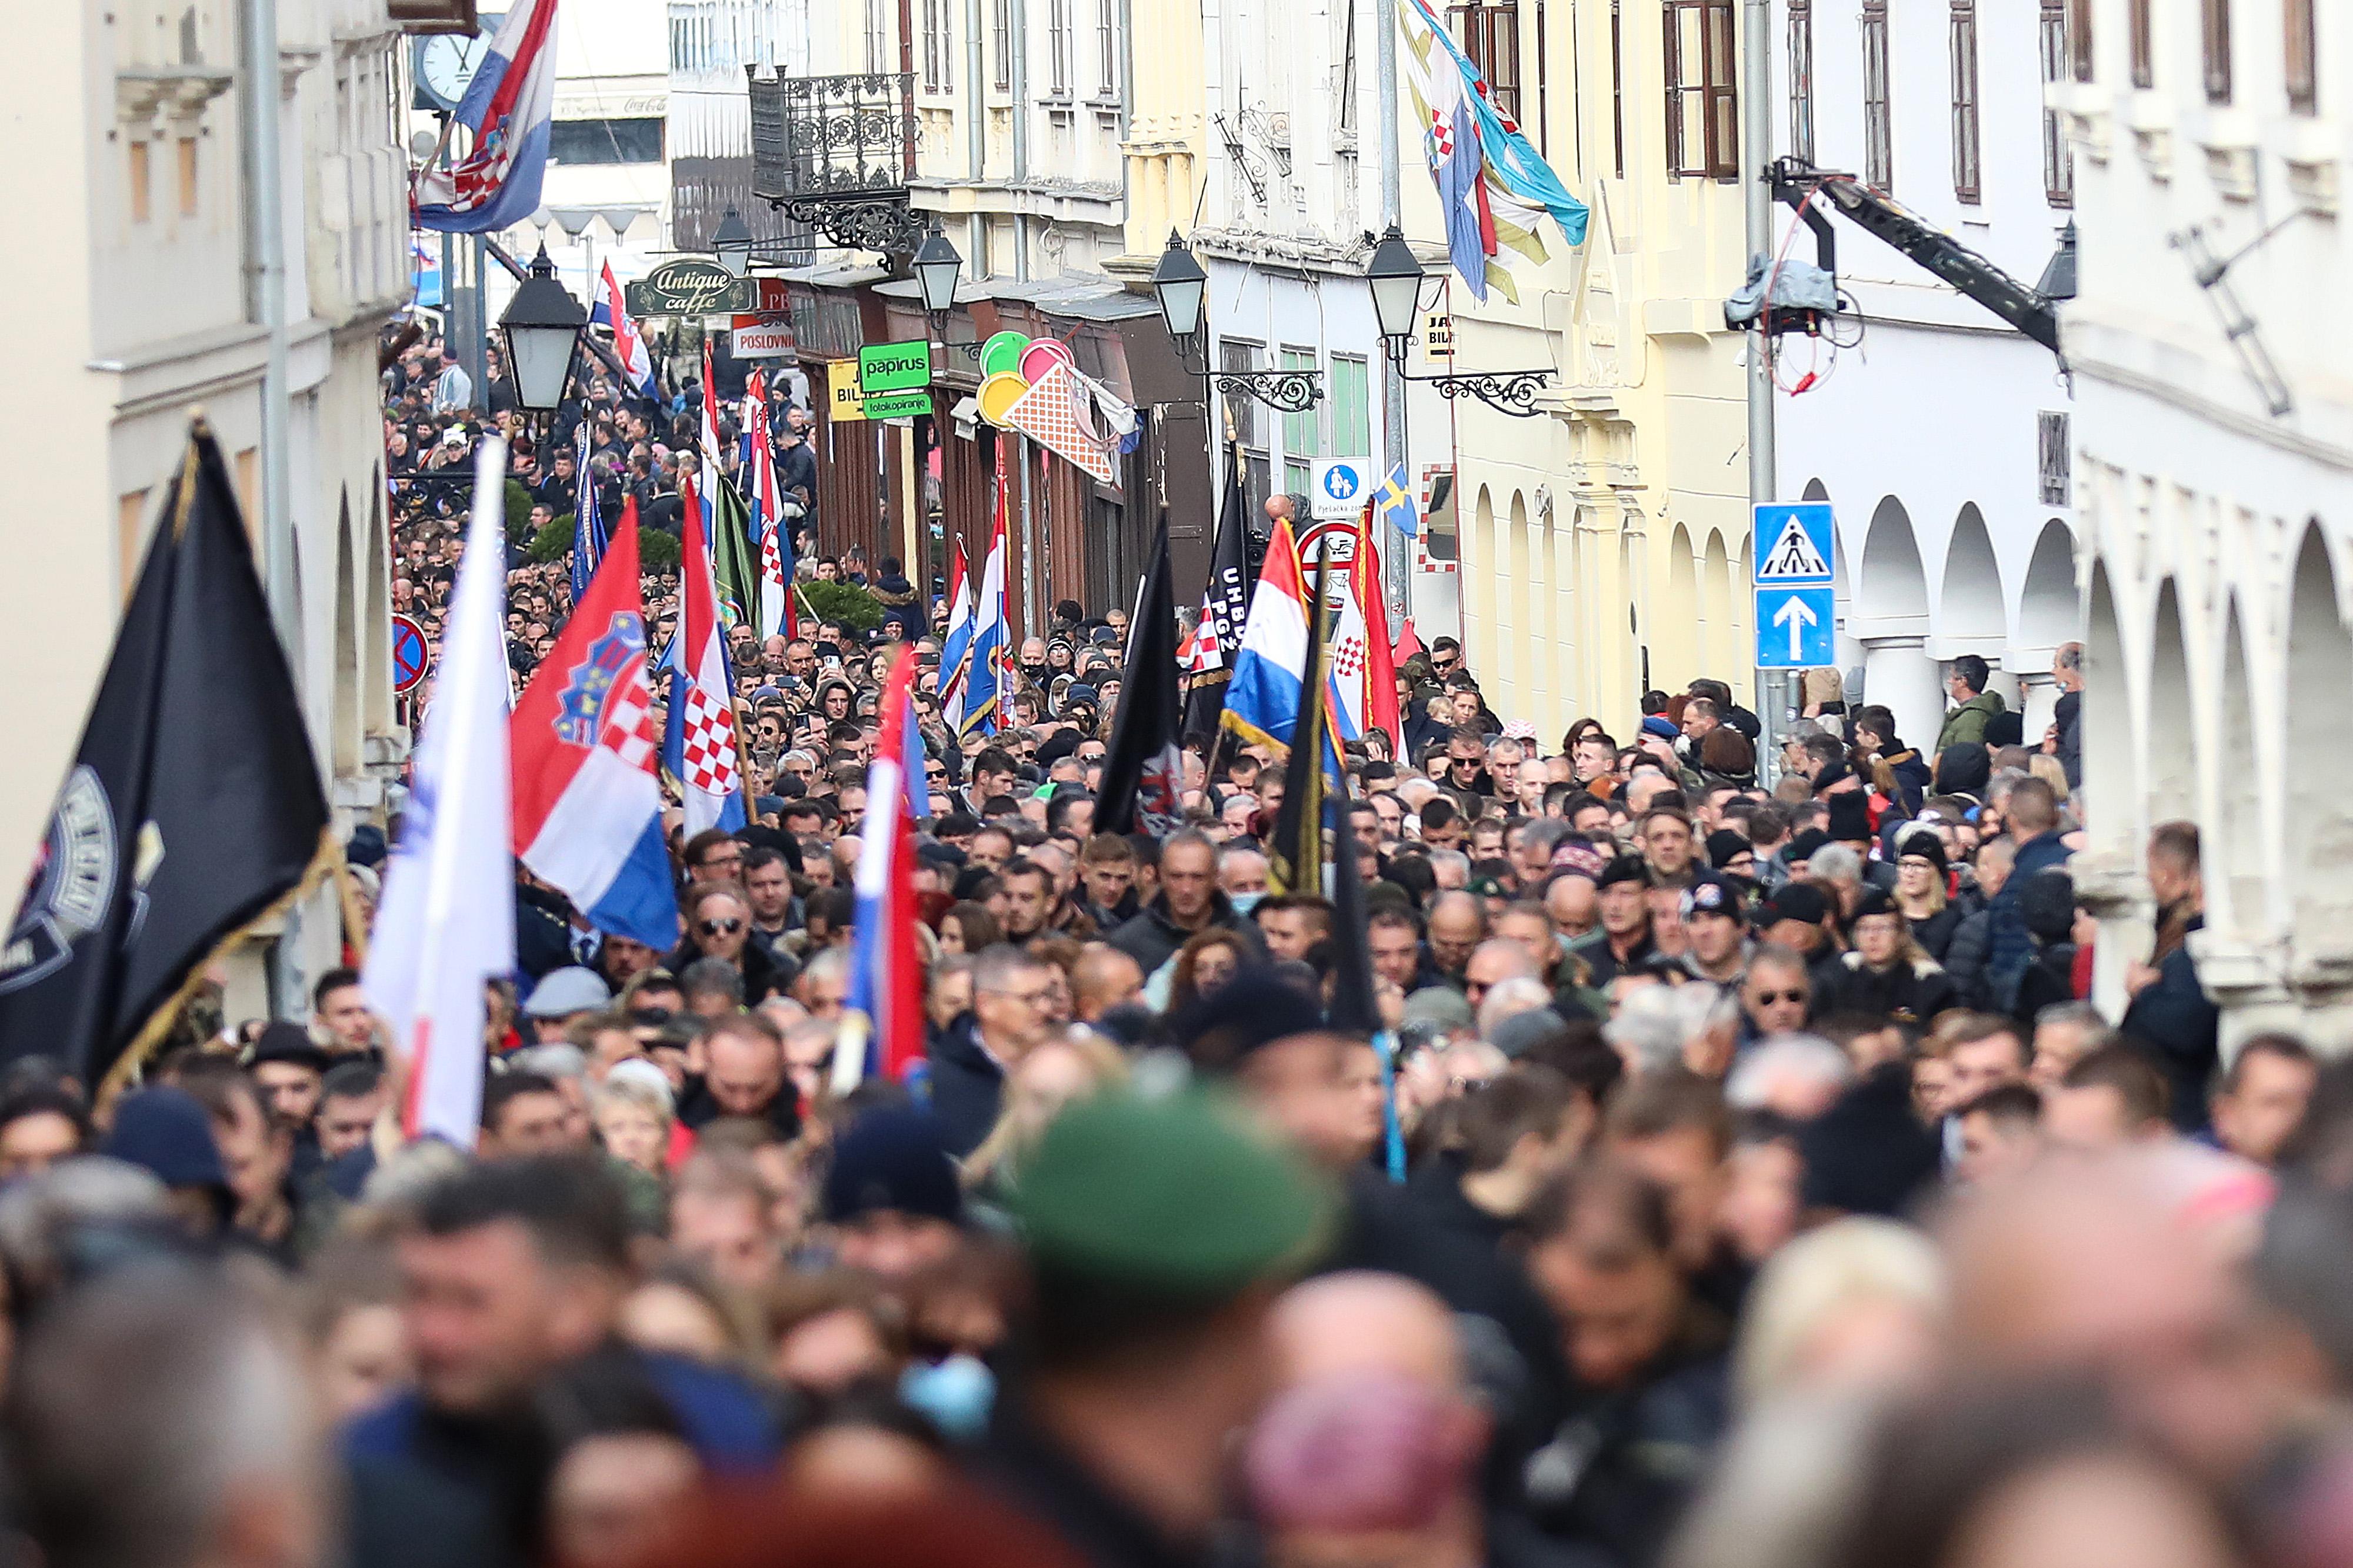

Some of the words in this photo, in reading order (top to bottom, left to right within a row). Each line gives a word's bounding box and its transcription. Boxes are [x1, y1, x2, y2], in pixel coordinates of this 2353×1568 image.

[656, 271, 728, 295] Antique
[665, 293, 716, 313] caffe
[866, 357, 925, 378] papirus
